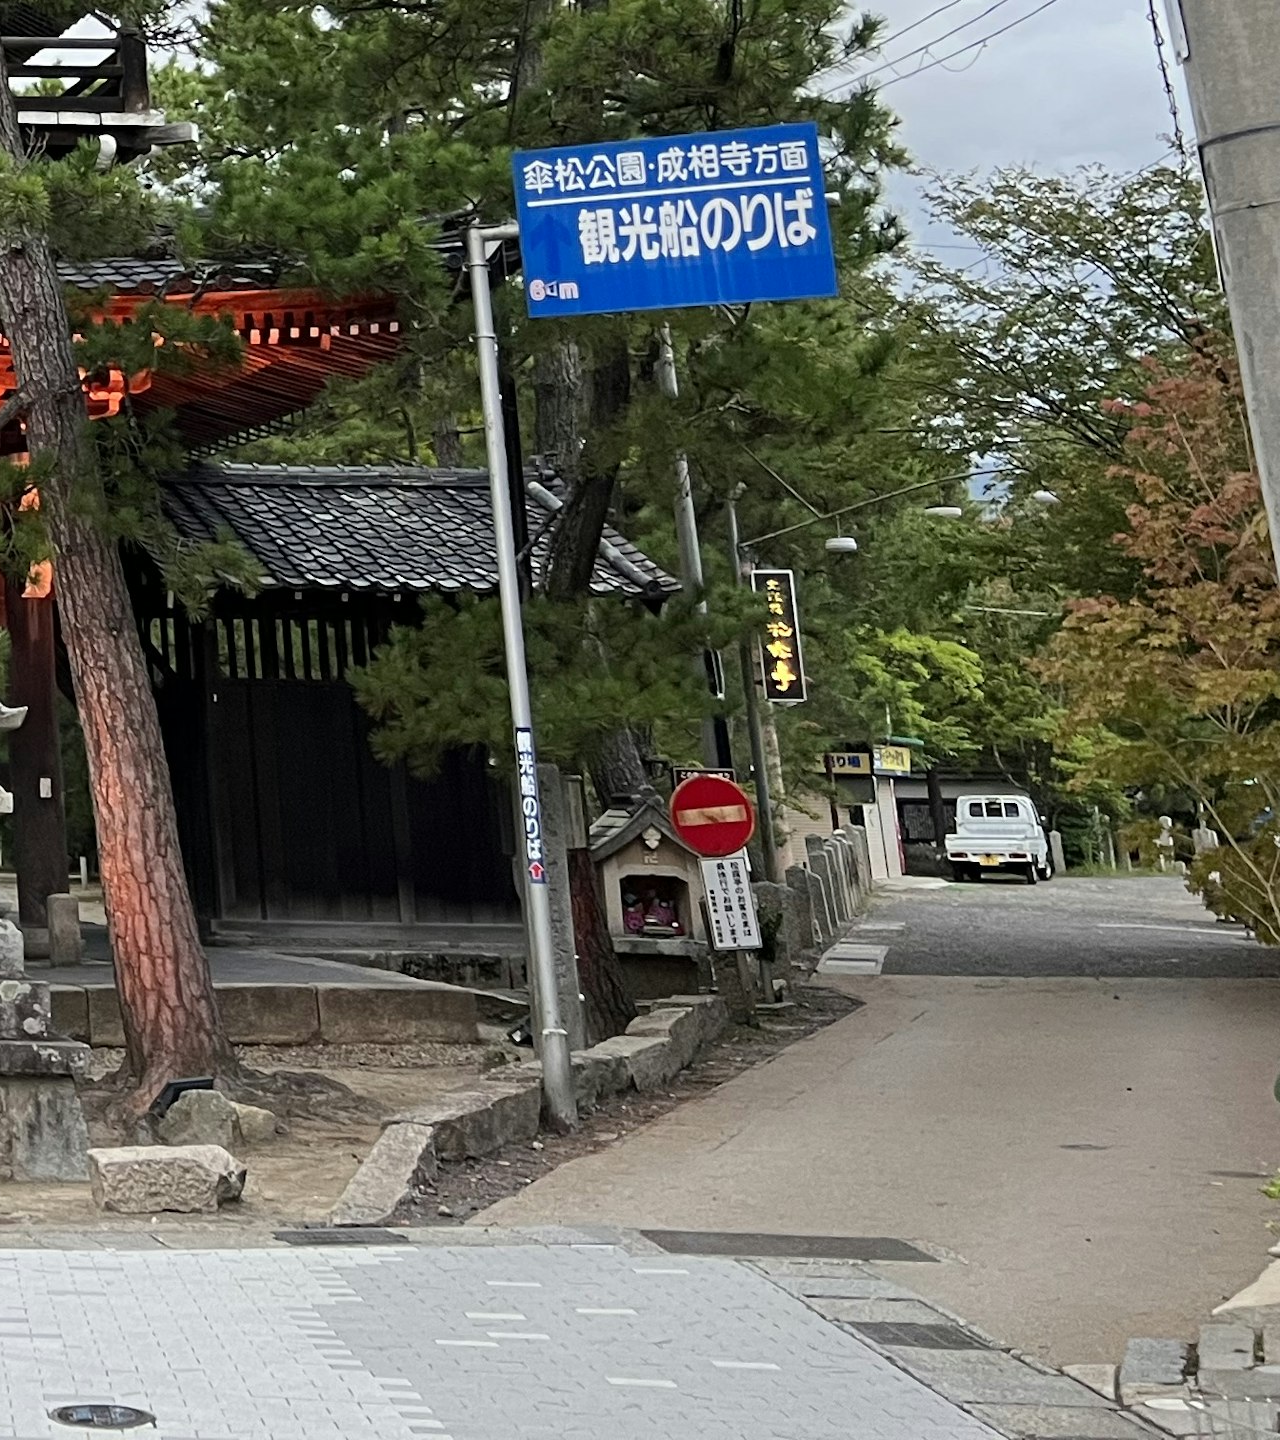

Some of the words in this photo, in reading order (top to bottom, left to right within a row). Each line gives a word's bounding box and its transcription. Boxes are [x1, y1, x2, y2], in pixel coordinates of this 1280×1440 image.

[523, 140, 809, 195] 傘松公園・成相寺方面
[578, 187, 817, 266] 観光船のりば
[516, 731, 542, 860] 観光船のりば
